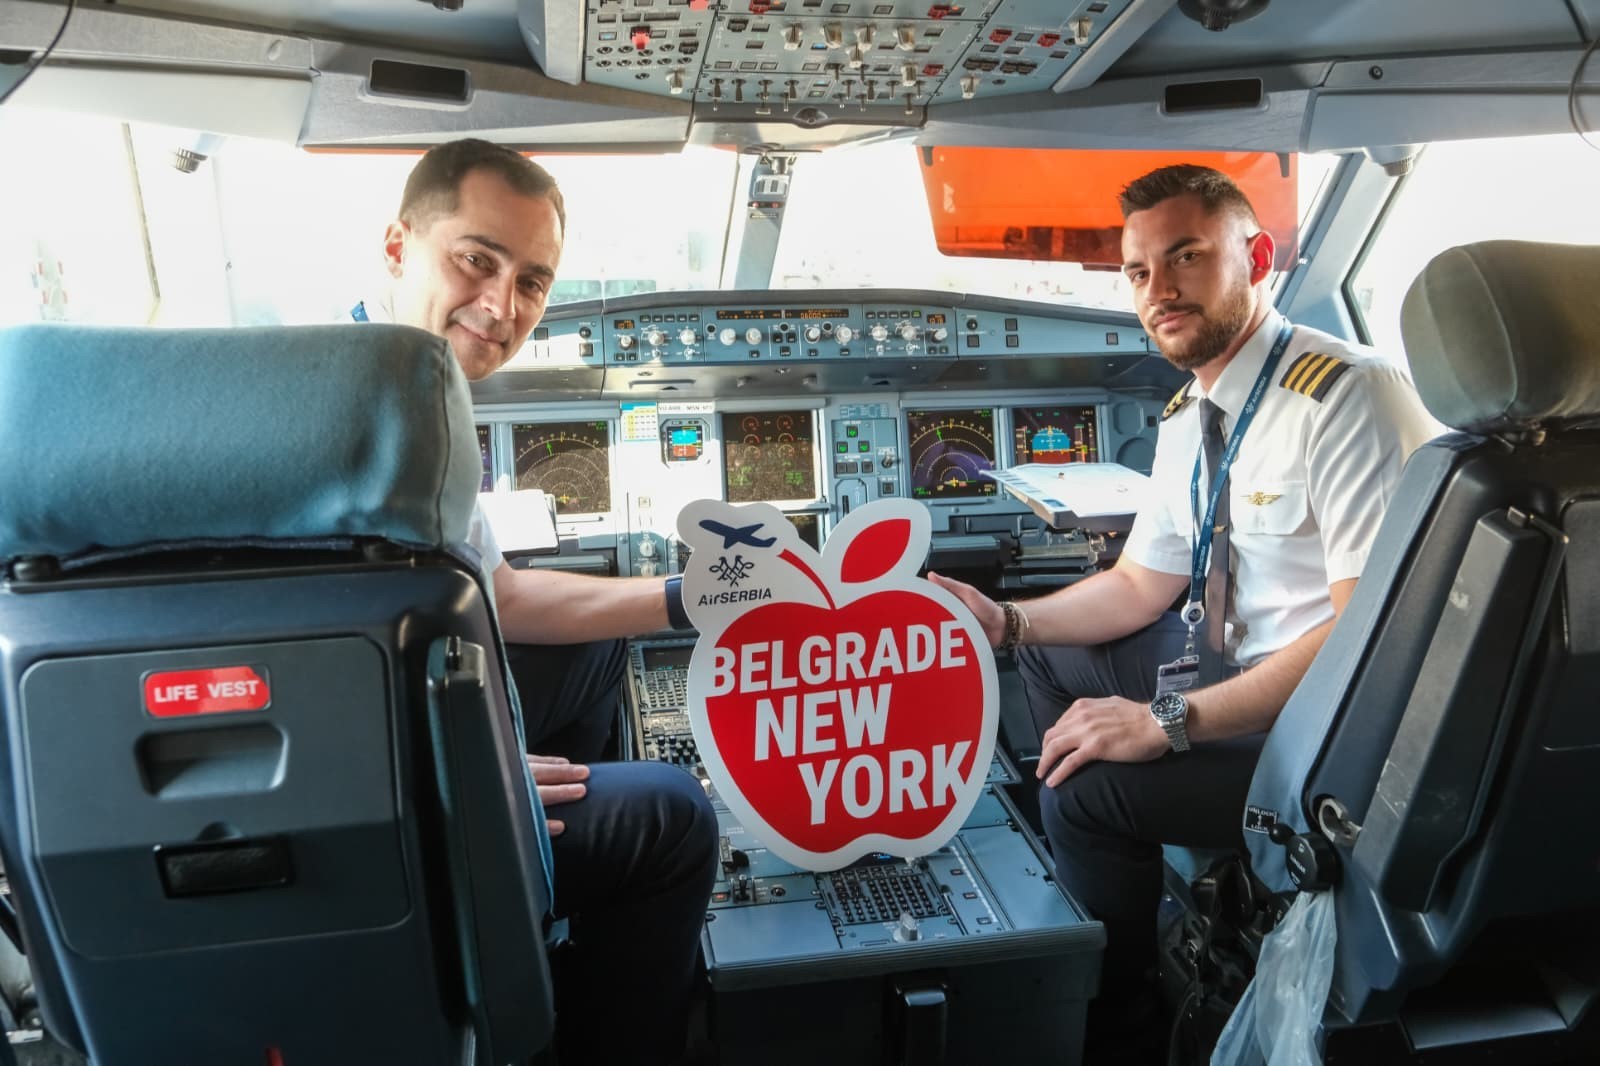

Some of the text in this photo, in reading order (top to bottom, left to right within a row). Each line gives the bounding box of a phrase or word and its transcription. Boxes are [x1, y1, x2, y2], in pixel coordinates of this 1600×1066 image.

[698, 588, 772, 606] AirSERBIA
[154, 680, 259, 703] LIFE VEST
[709, 620, 967, 697] BELGRADE
[754, 683, 893, 761] NEW
[798, 740, 973, 826] YORK
